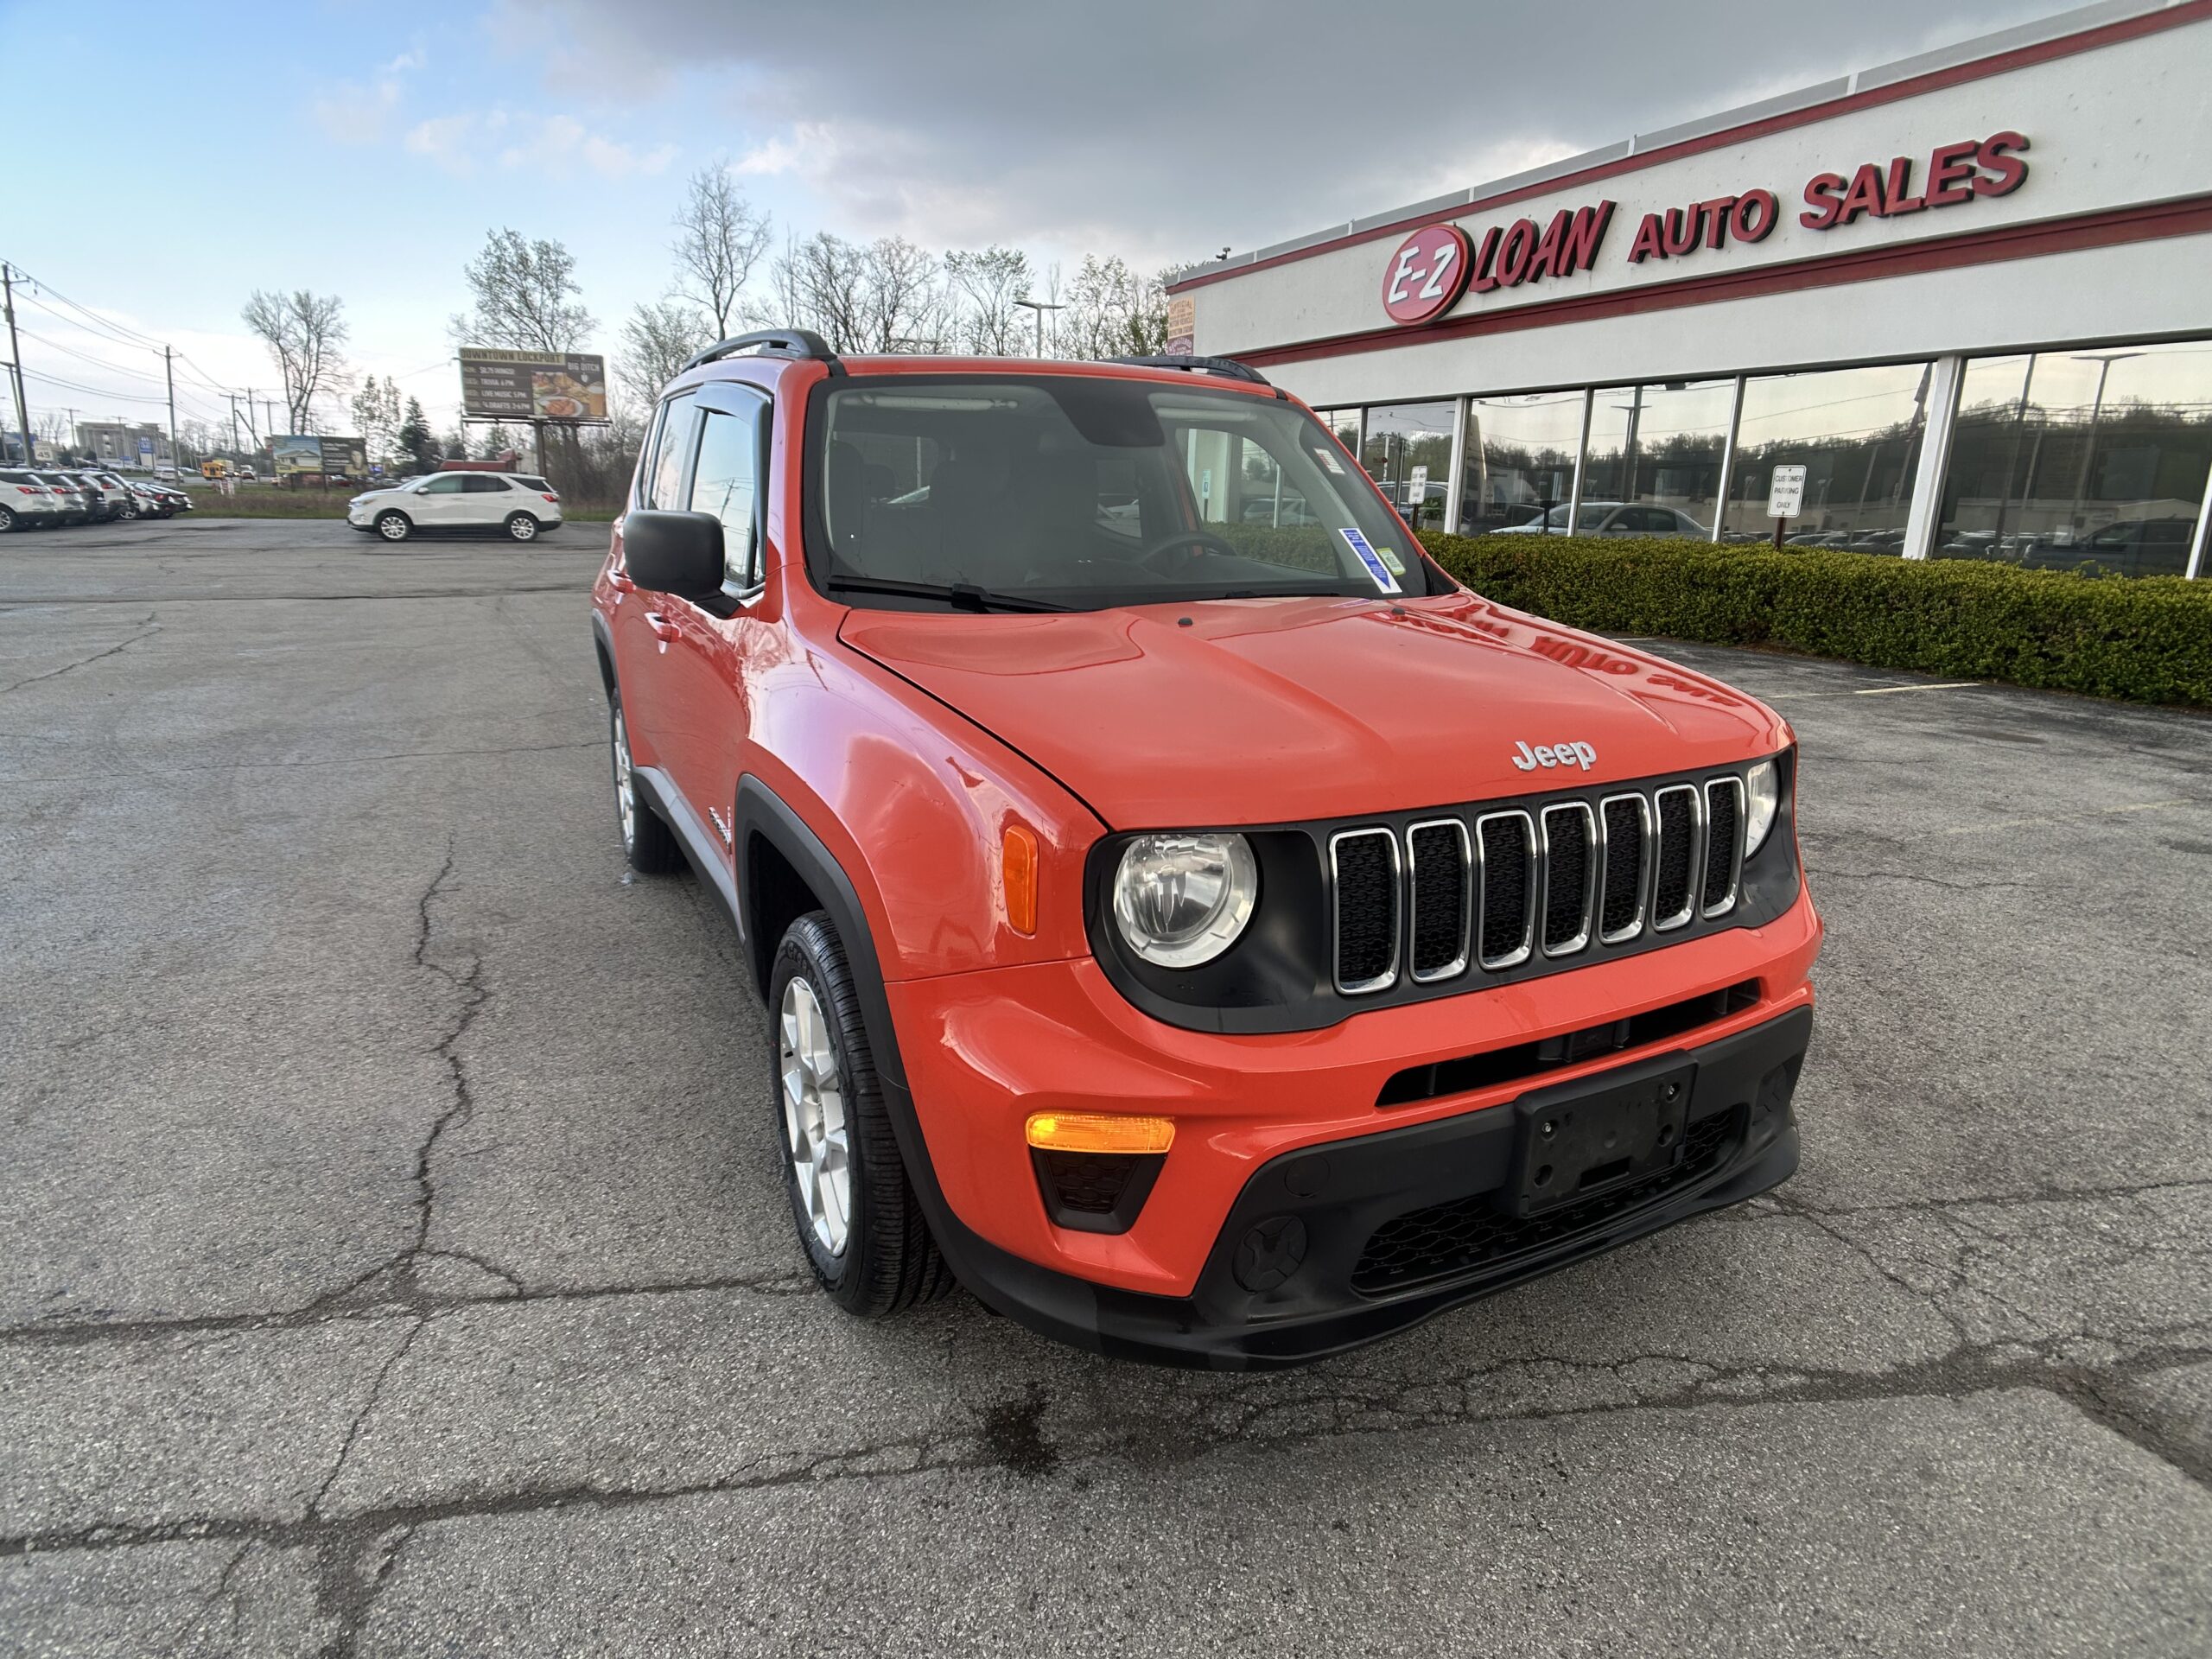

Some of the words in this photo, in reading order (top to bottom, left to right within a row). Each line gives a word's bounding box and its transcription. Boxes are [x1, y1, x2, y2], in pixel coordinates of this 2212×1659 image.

[1389, 243, 1456, 303] E-Z
[1469, 200, 1617, 293] LOAN
[1628, 188, 1780, 263] AUTO
[1799, 130, 2031, 230] SALES
[461, 348, 514, 361] DOWNTOWN
[518, 352, 562, 363] LOCKPORT
[567, 361, 579, 371] BIG
[1512, 741, 1597, 772] Jeep
